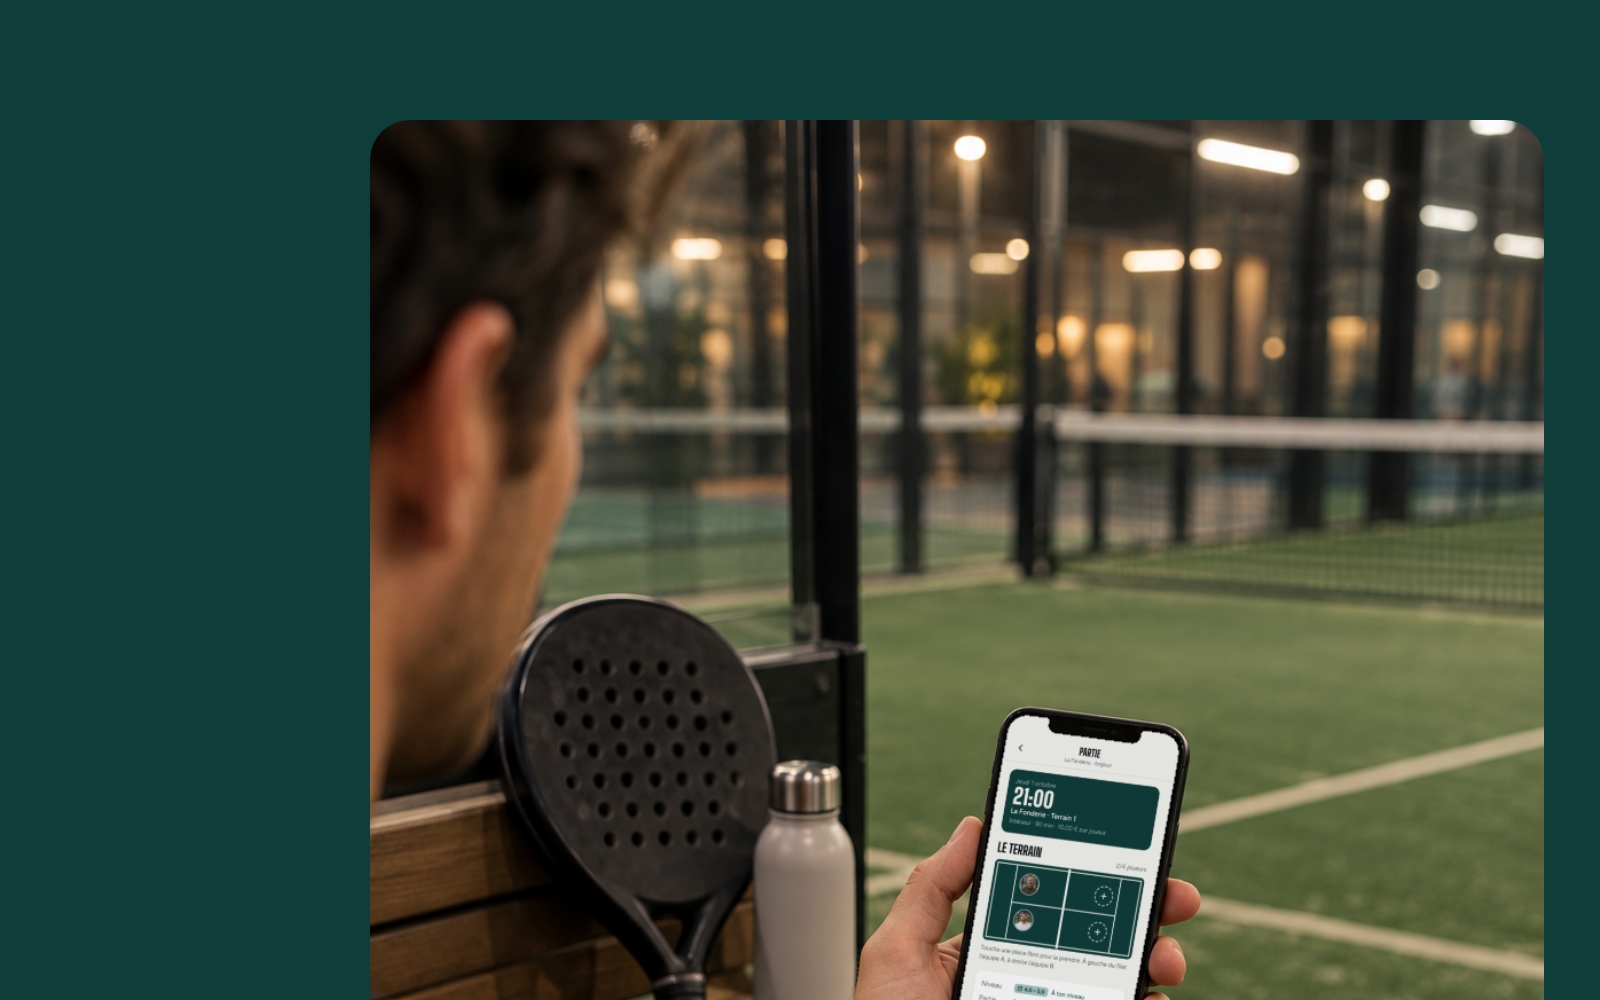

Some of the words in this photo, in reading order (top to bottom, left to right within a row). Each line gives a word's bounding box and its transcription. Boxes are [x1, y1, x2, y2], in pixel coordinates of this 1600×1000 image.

[1079, 747, 1102, 758] PARTIE
[1013, 786, 1054, 809] 21:00
[1019, 809, 1046, 818] Fonderie
[1051, 813, 1072, 821] Terrain
[997, 841, 1007, 854] LE
[1009, 842, 1042, 858] TERRAIN
[981, 980, 1002, 989] Niveau
